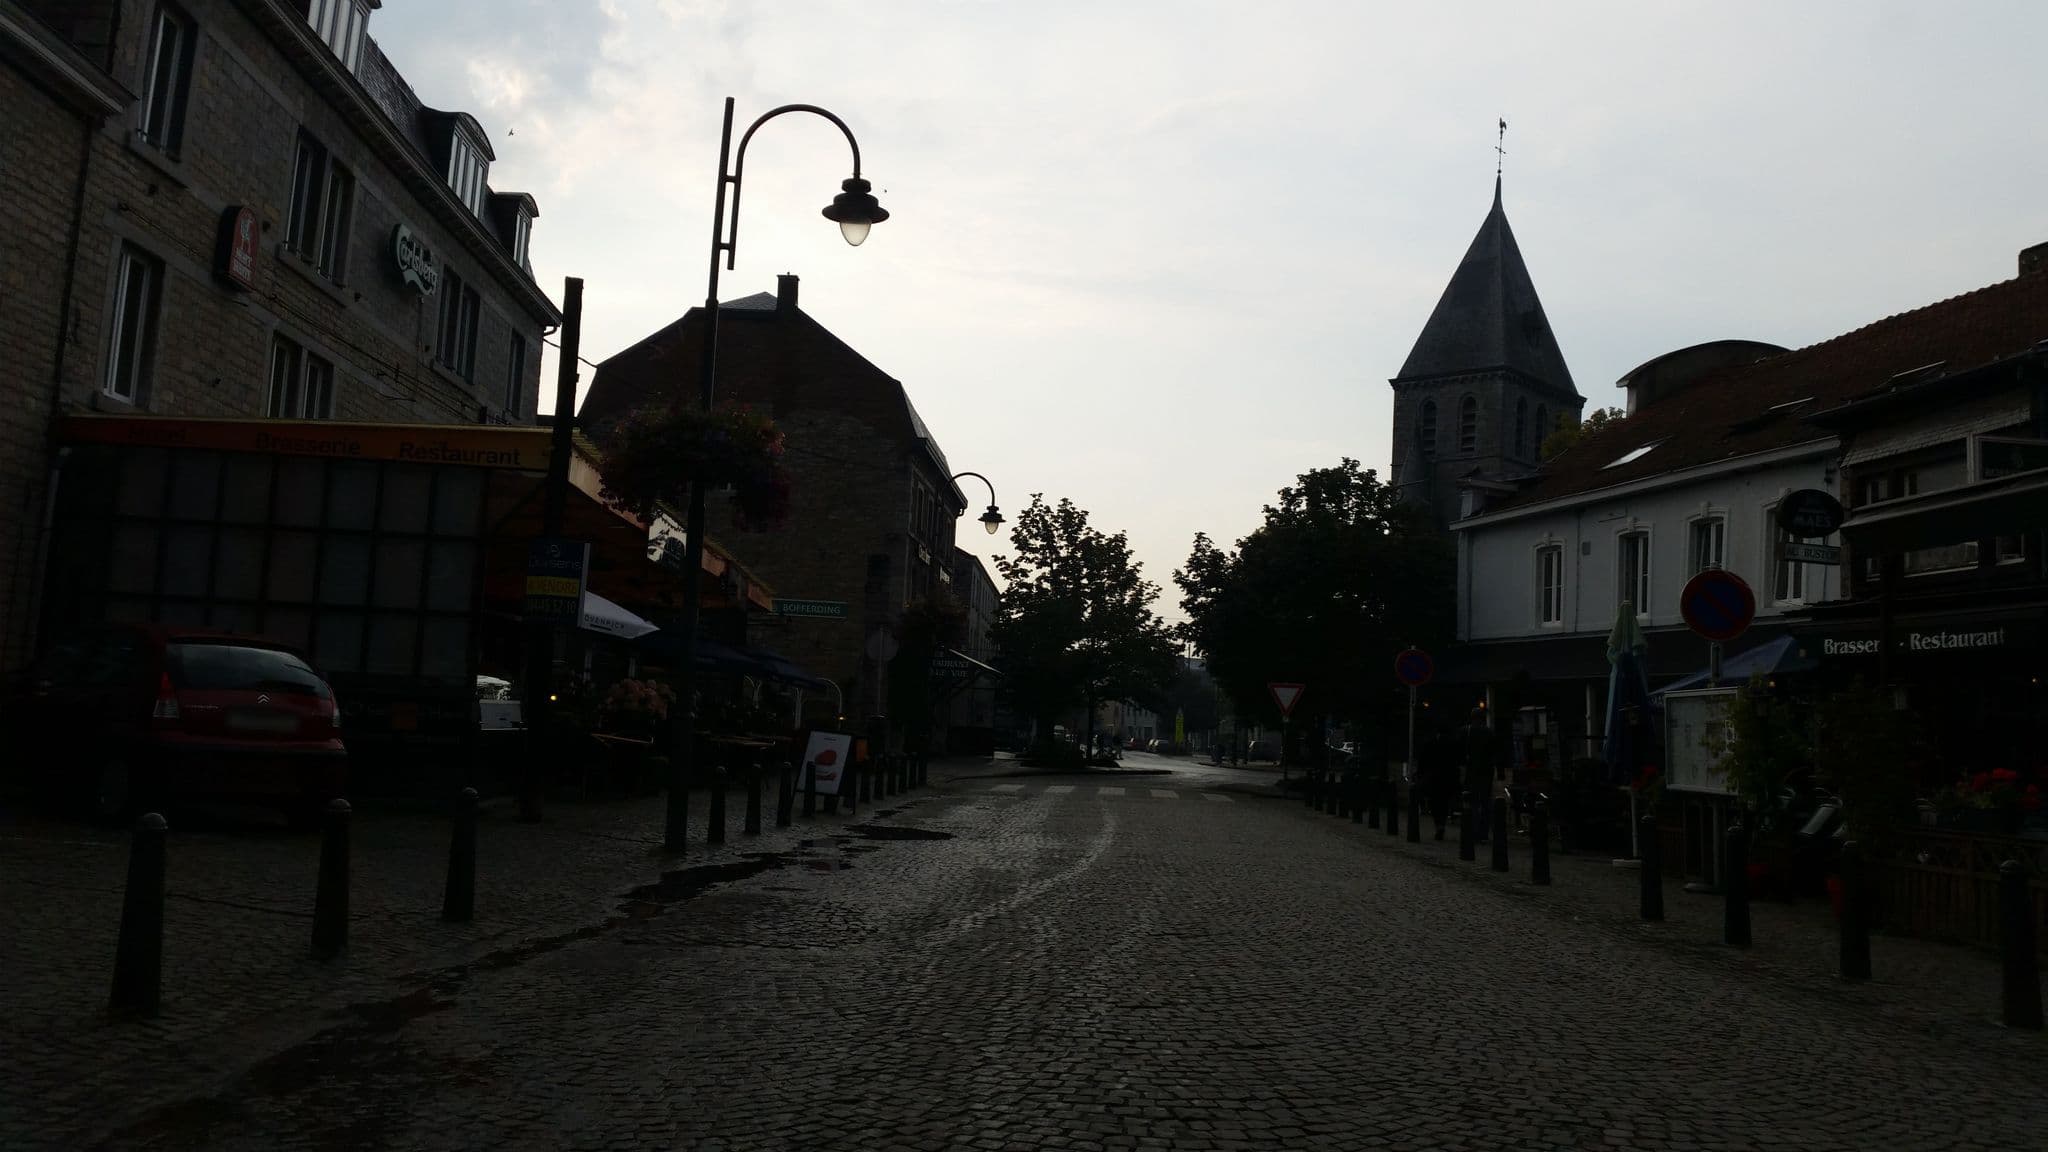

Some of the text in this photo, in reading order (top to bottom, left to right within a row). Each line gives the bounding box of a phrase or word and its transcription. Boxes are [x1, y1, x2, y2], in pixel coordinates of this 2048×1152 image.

[396, 225, 437, 294] Carlsberg
[255, 430, 362, 456] Brasserie
[400, 440, 521, 465] Restaurant
[783, 601, 841, 615] BOFFERDING
[1823, 624, 2007, 656] Brasser Restaurant
